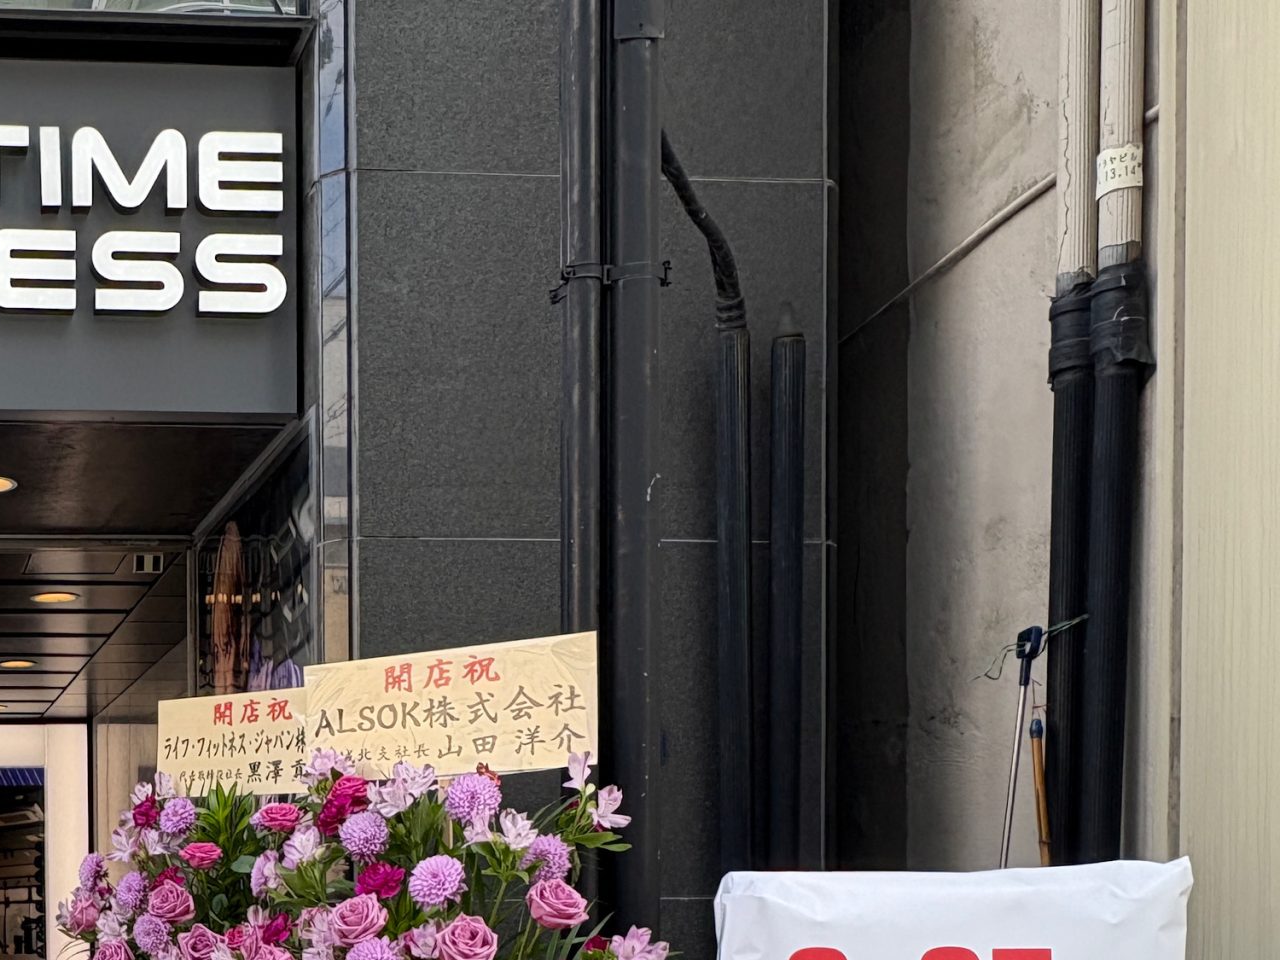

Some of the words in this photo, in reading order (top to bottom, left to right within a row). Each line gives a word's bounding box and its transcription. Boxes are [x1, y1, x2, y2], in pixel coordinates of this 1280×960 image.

[384, 655, 501, 693] 開店祝
[213, 697, 293, 726] 開店祝
[314, 683, 587, 738] ALSOK株式会社
